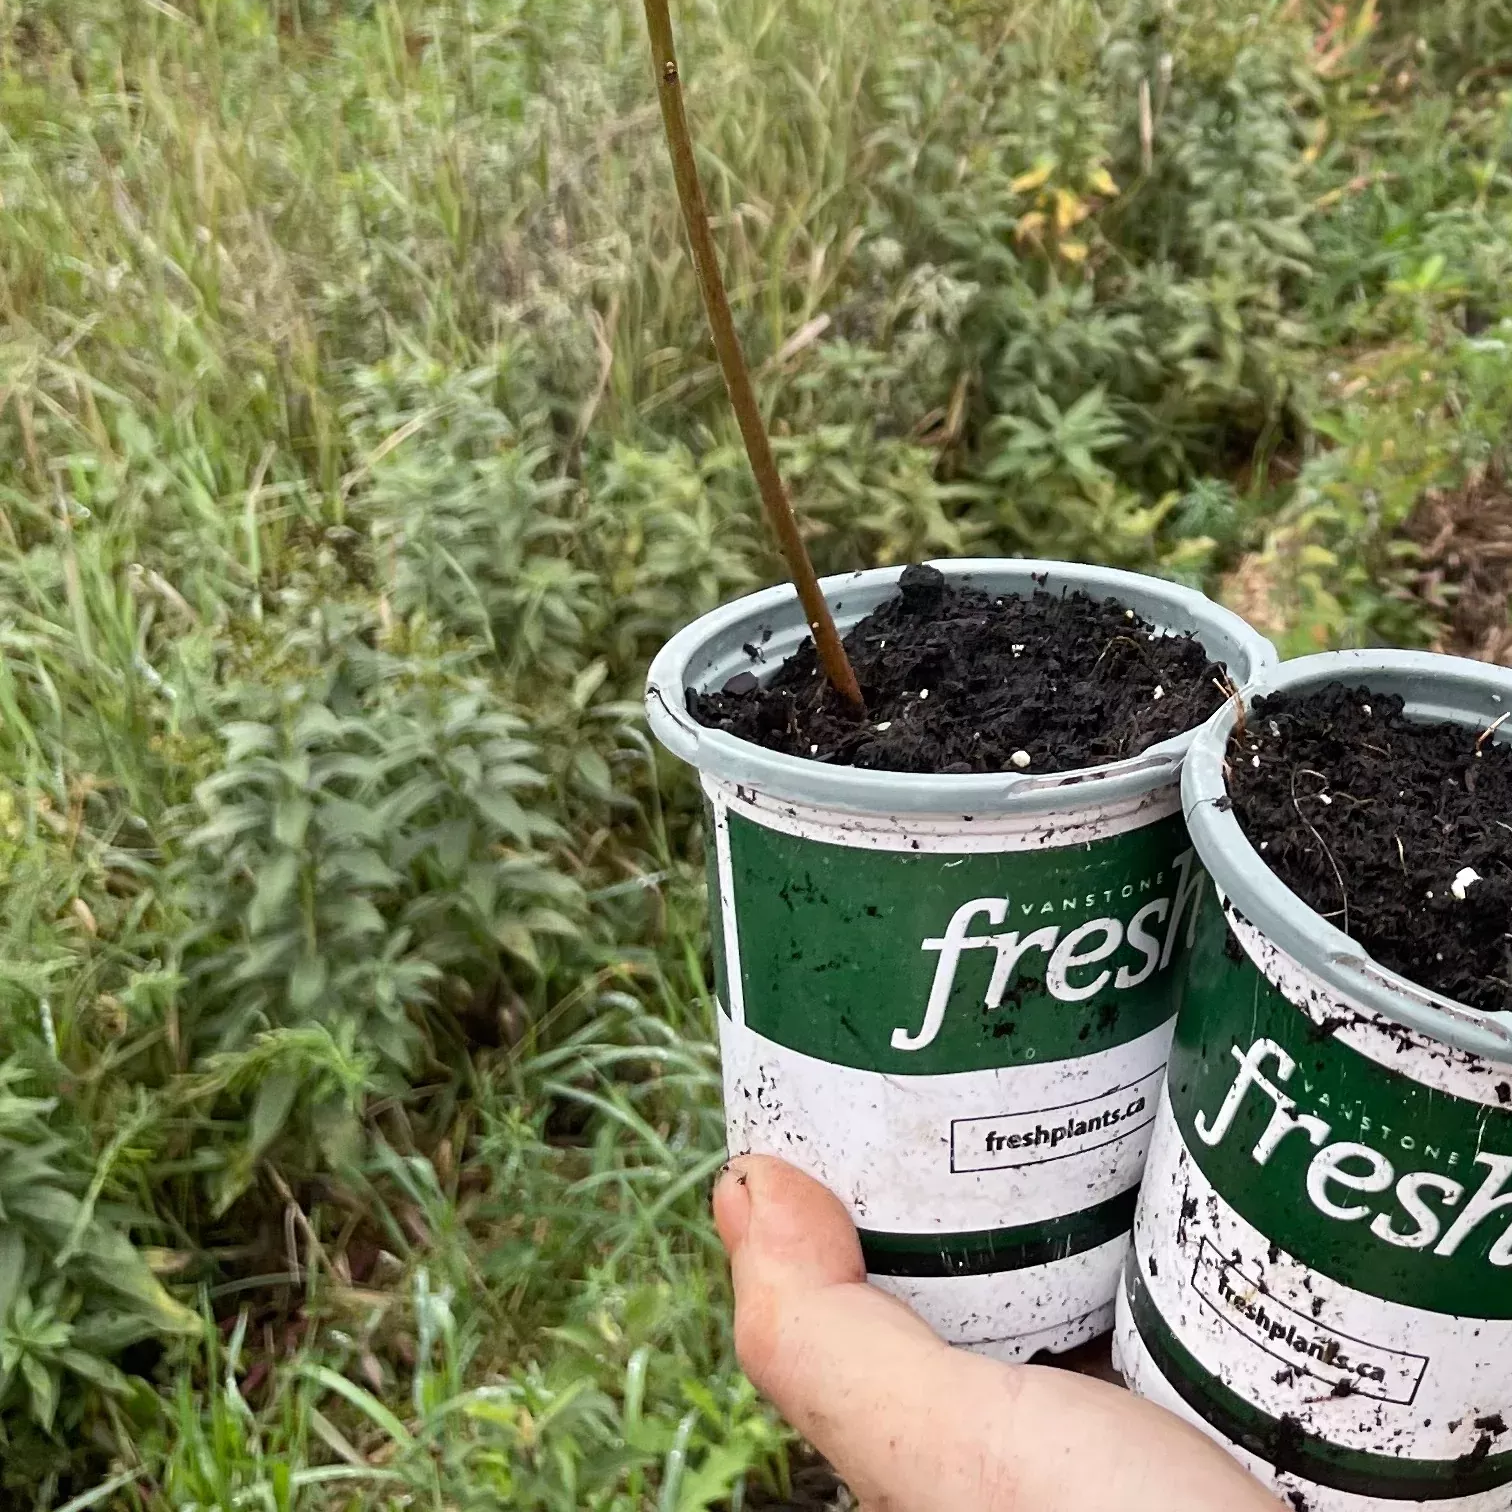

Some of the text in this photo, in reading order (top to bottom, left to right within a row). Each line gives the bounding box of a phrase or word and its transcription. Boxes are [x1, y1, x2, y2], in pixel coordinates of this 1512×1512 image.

[1021, 871, 1164, 916] VANSTONE
[890, 845, 1206, 1051] fresh
[985, 1097, 1145, 1151] freshplants.ca
